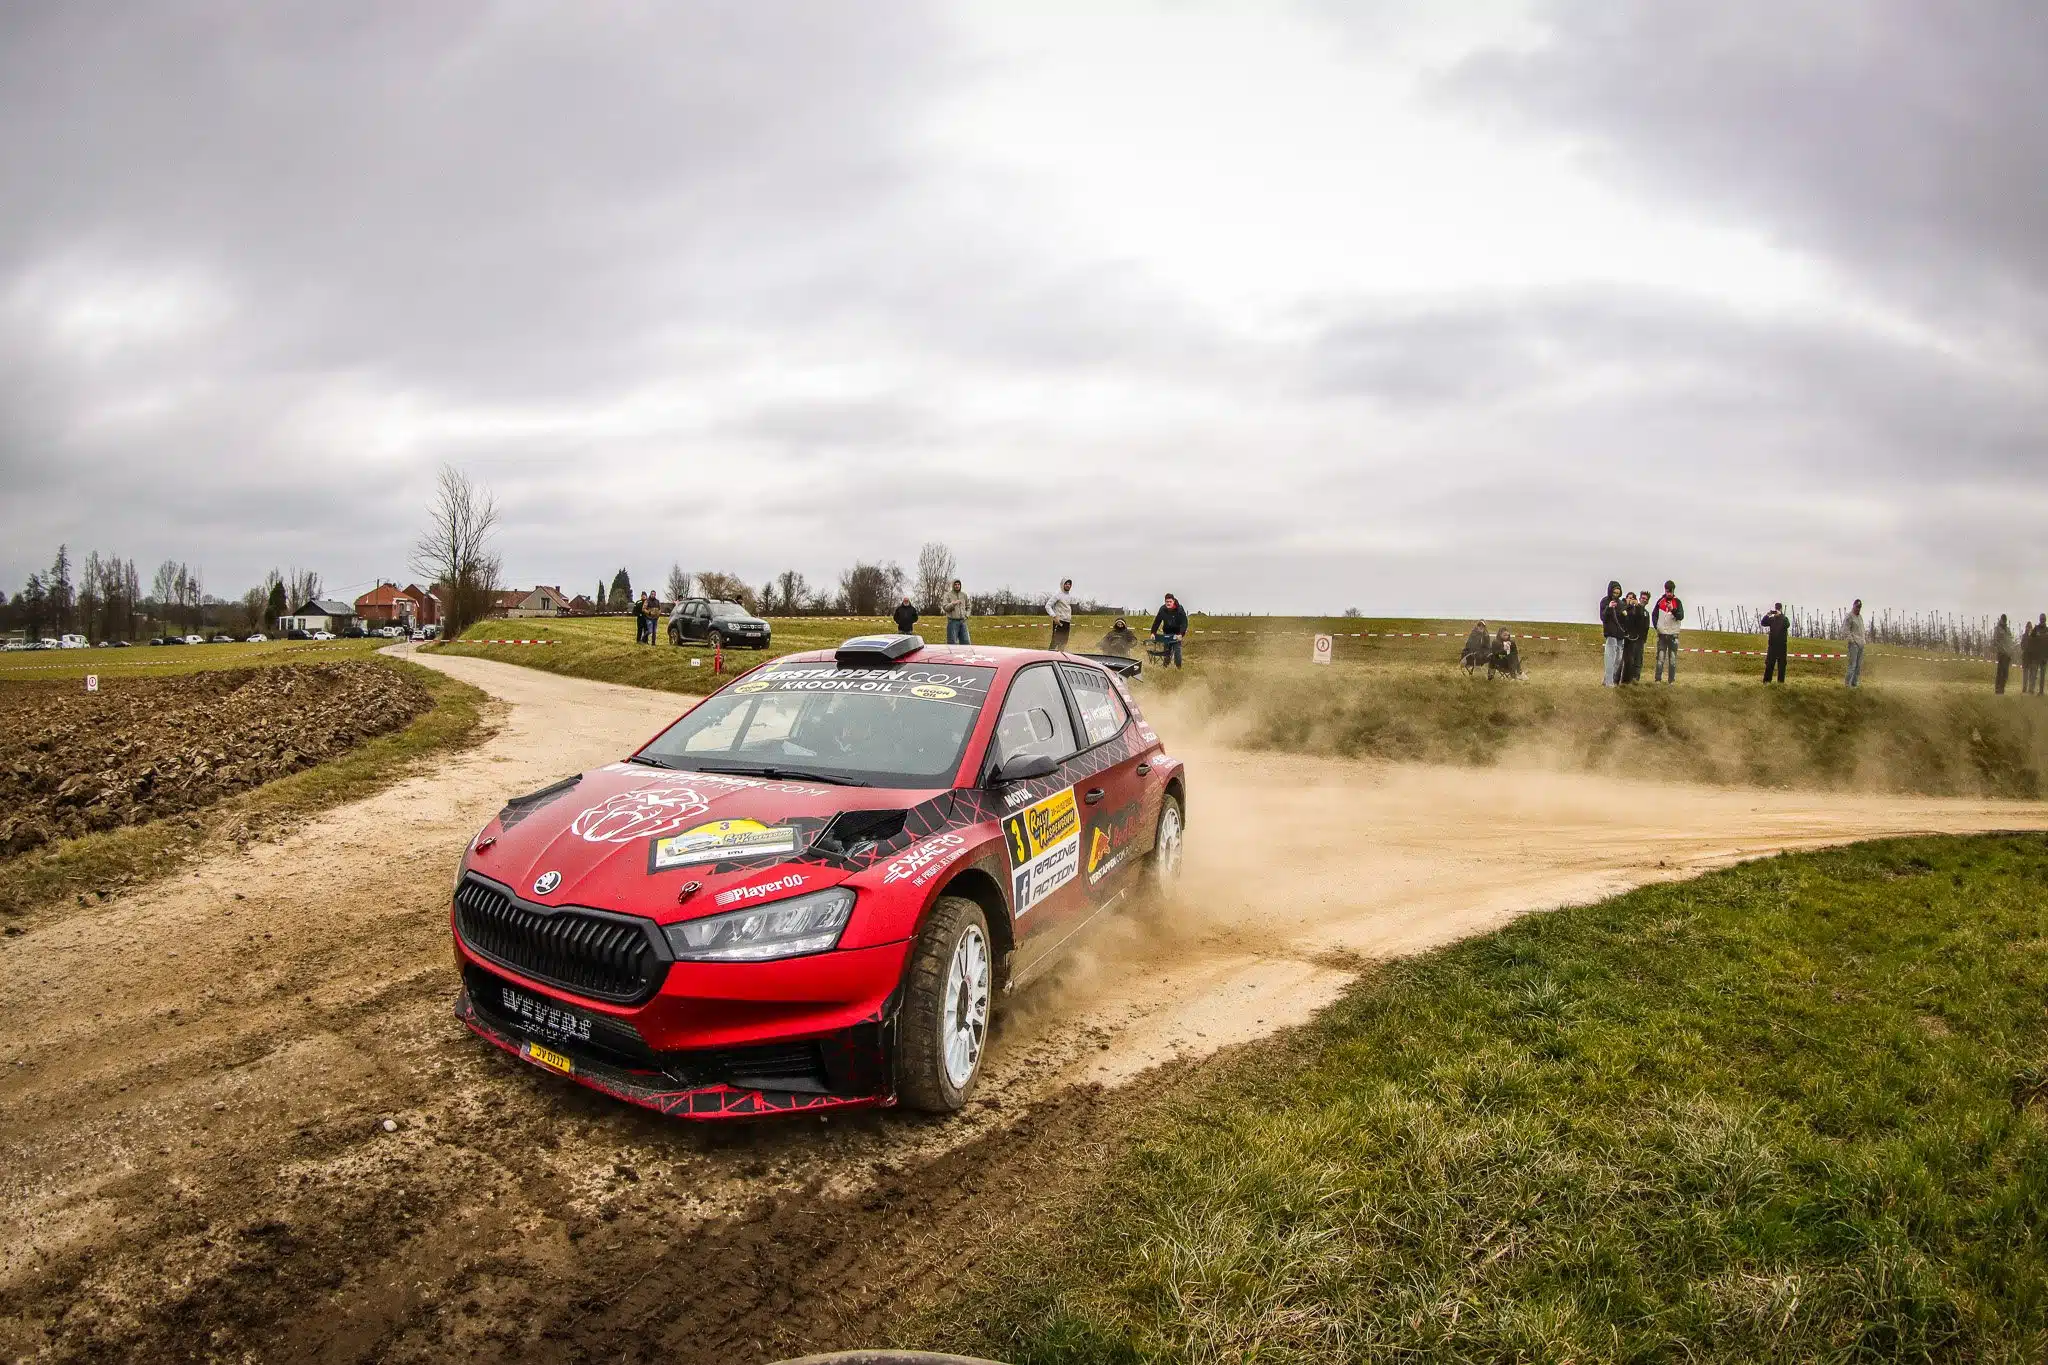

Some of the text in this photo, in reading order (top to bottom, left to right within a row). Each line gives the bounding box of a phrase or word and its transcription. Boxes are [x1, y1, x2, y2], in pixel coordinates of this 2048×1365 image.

[748, 668, 977, 688] VERSTAPPEN.COM
[780, 680, 893, 693] KROON-OIL
[915, 687, 951, 696] KROON
[1004, 787, 1033, 808] MOTUL
[719, 821, 730, 831] 3
[1011, 818, 1025, 863] 3
[1033, 841, 1077, 879] RACING
[733, 879, 784, 901] Player
[911, 876, 927, 889] THE
[1033, 861, 1077, 901] ACTION
